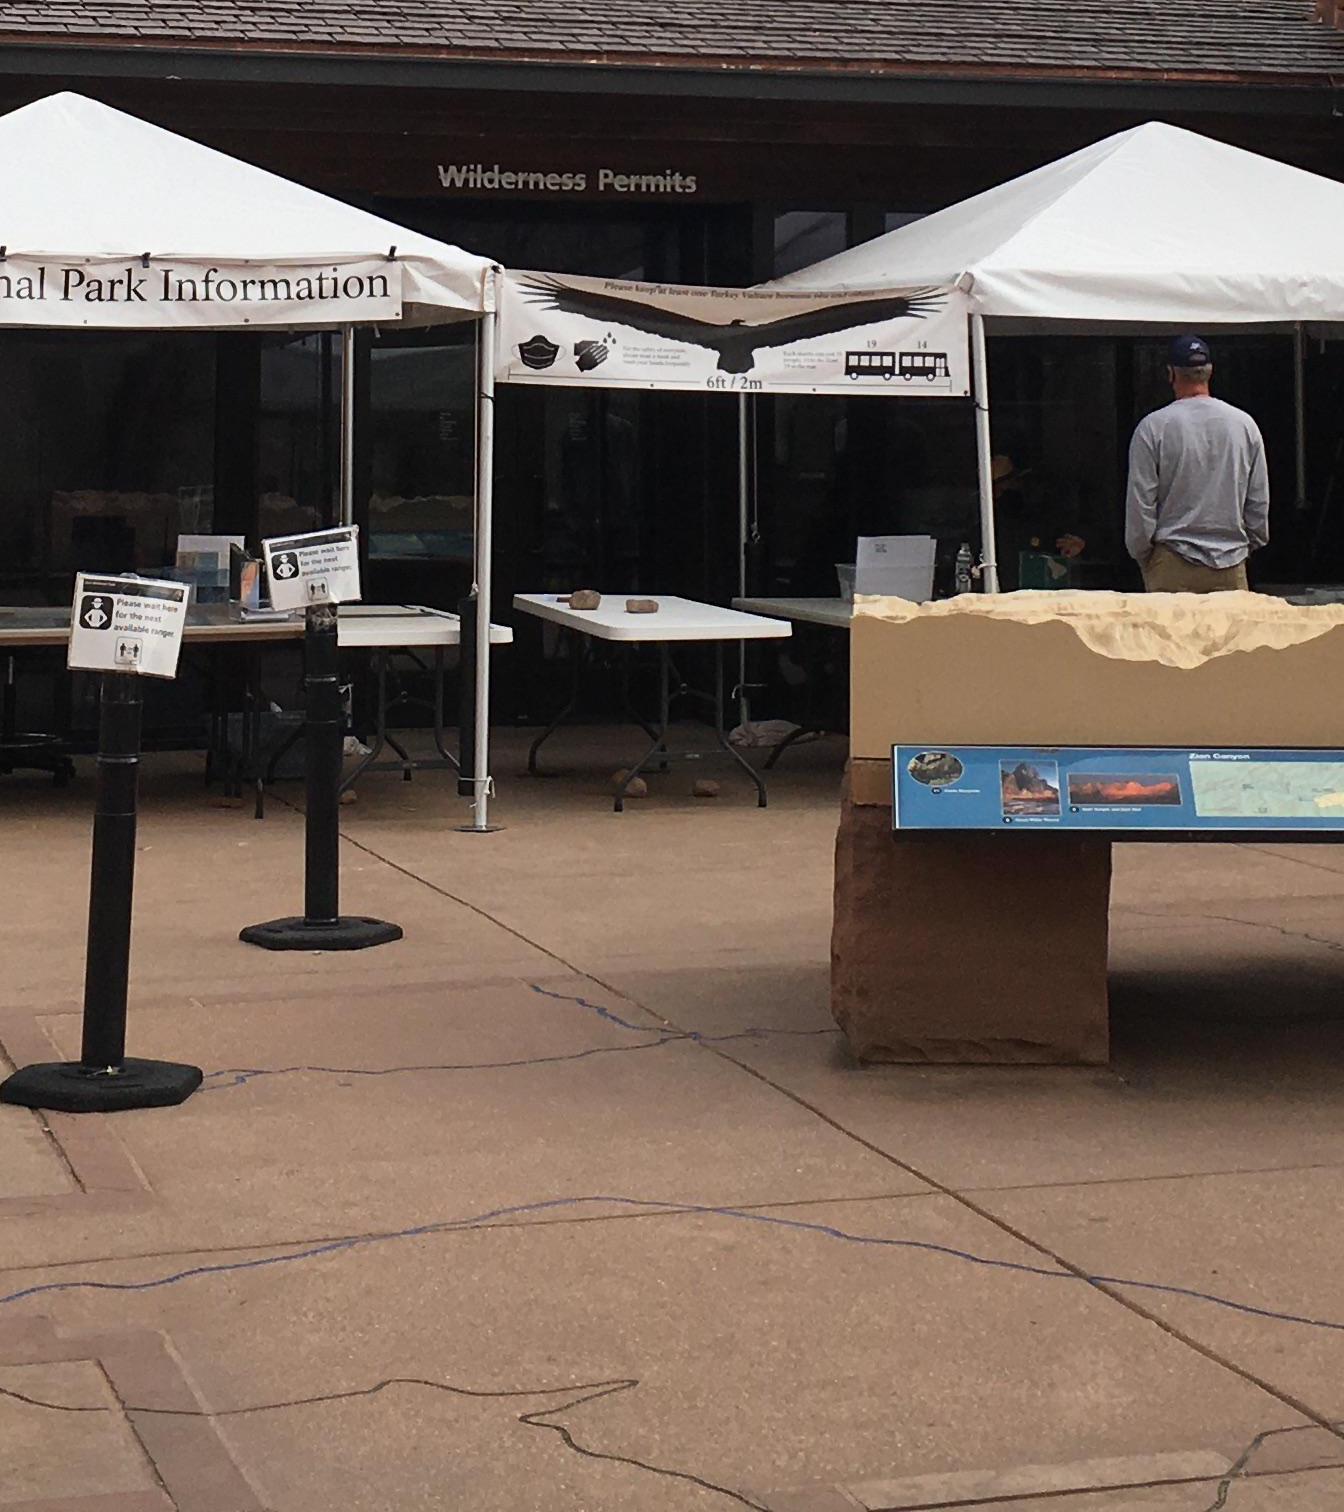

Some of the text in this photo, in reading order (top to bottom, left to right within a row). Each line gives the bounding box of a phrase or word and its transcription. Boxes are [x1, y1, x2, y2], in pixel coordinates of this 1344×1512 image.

[438, 164, 697, 193] Wilderness Permits
[60, 266, 148, 303] Park
[159, 267, 392, 303] Information
[604, 281, 634, 292] Please
[668, 287, 689, 296] least
[711, 289, 738, 300] Turkey
[742, 290, 774, 299] Vulture
[866, 340, 877, 349] 19
[917, 341, 927, 349] 14
[706, 375, 726, 389] 6ft
[740, 376, 763, 390] 2m
[299, 549, 319, 557] Please
[116, 598, 179, 614] Please wait here
[115, 610, 162, 623] for the next
[114, 624, 150, 634] available
[1212, 753, 1251, 761] Canyon
